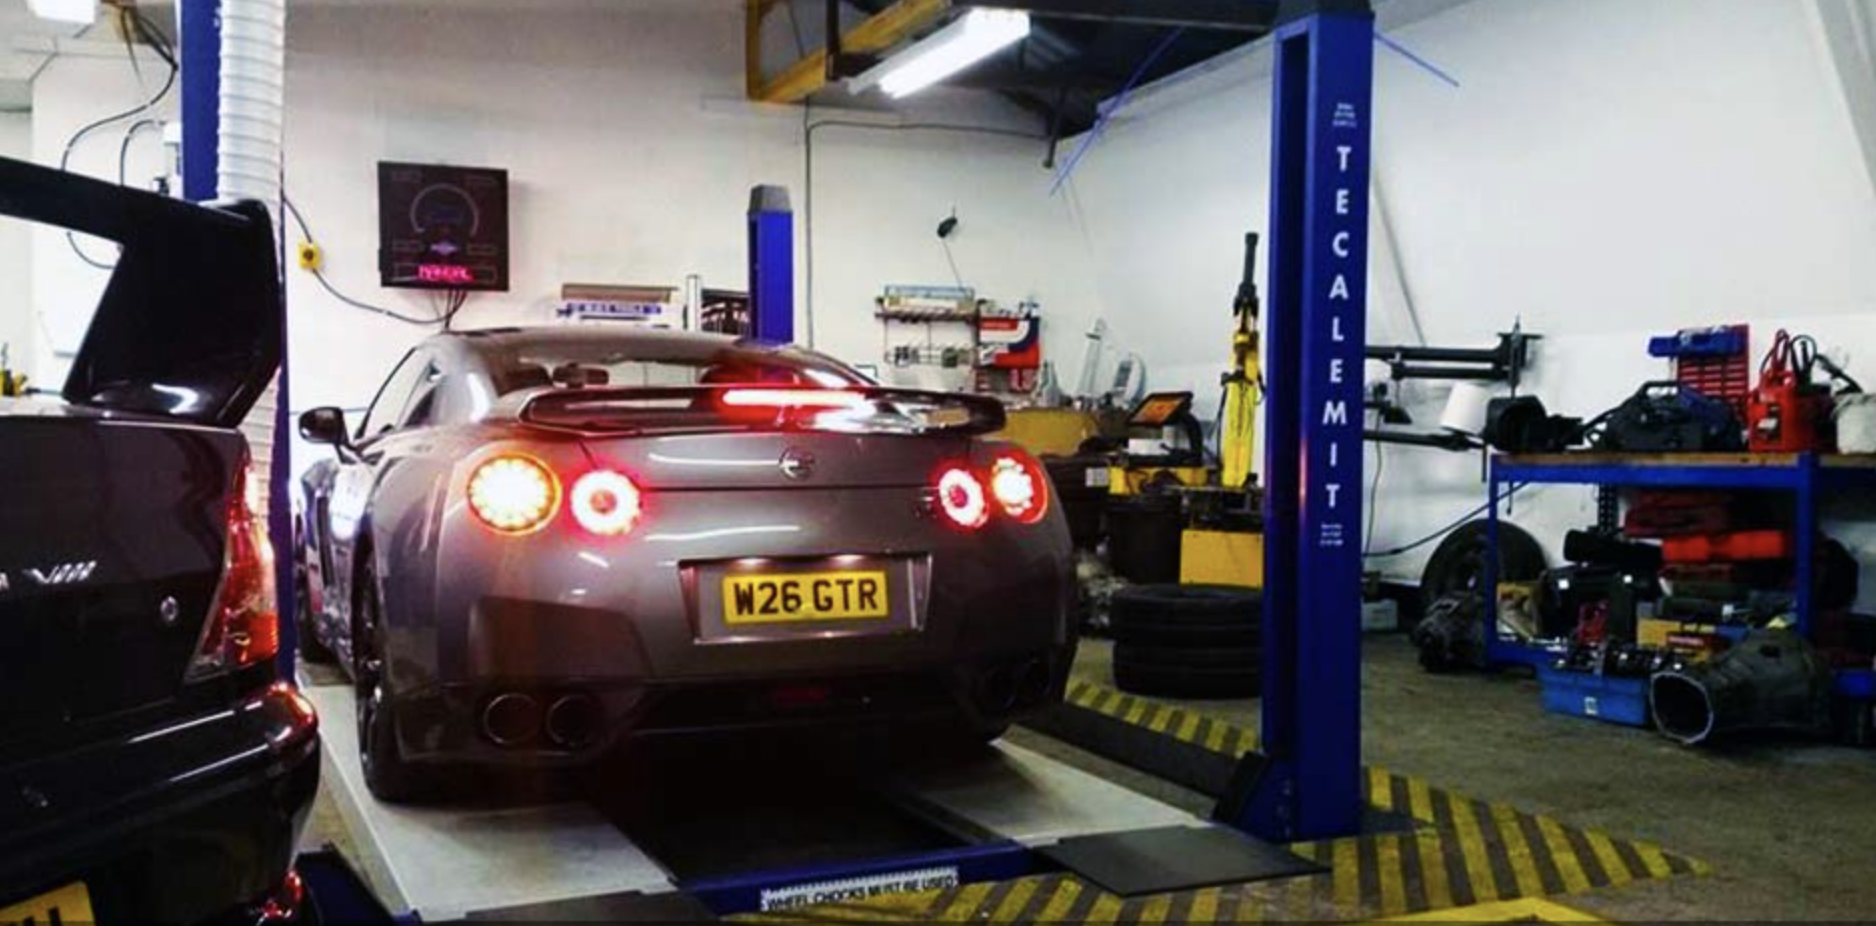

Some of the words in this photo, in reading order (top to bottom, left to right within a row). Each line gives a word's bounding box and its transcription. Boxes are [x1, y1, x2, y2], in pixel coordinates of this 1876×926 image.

[1322, 145, 1353, 509] TECALEMIT
[734, 581, 802, 615] W26
[812, 579, 877, 612] GTR
